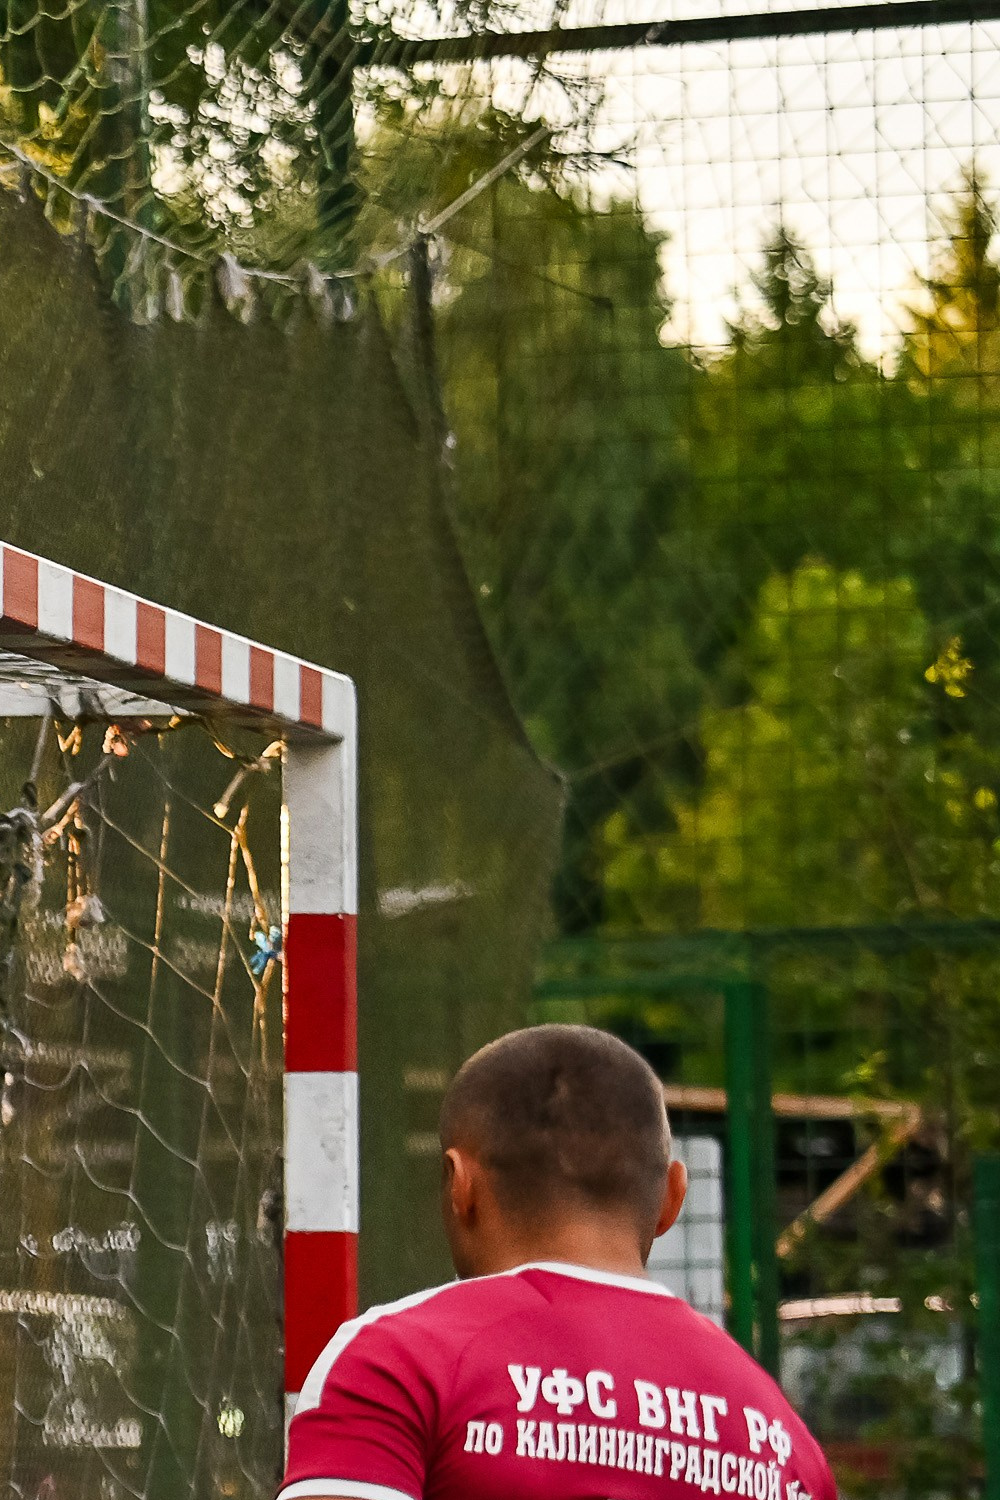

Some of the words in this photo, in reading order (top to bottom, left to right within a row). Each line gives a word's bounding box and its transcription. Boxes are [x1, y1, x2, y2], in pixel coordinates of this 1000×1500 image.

[508, 1364, 617, 1418] УФС
[634, 1379, 728, 1442] ВНГ
[743, 1407, 792, 1466] РФ
